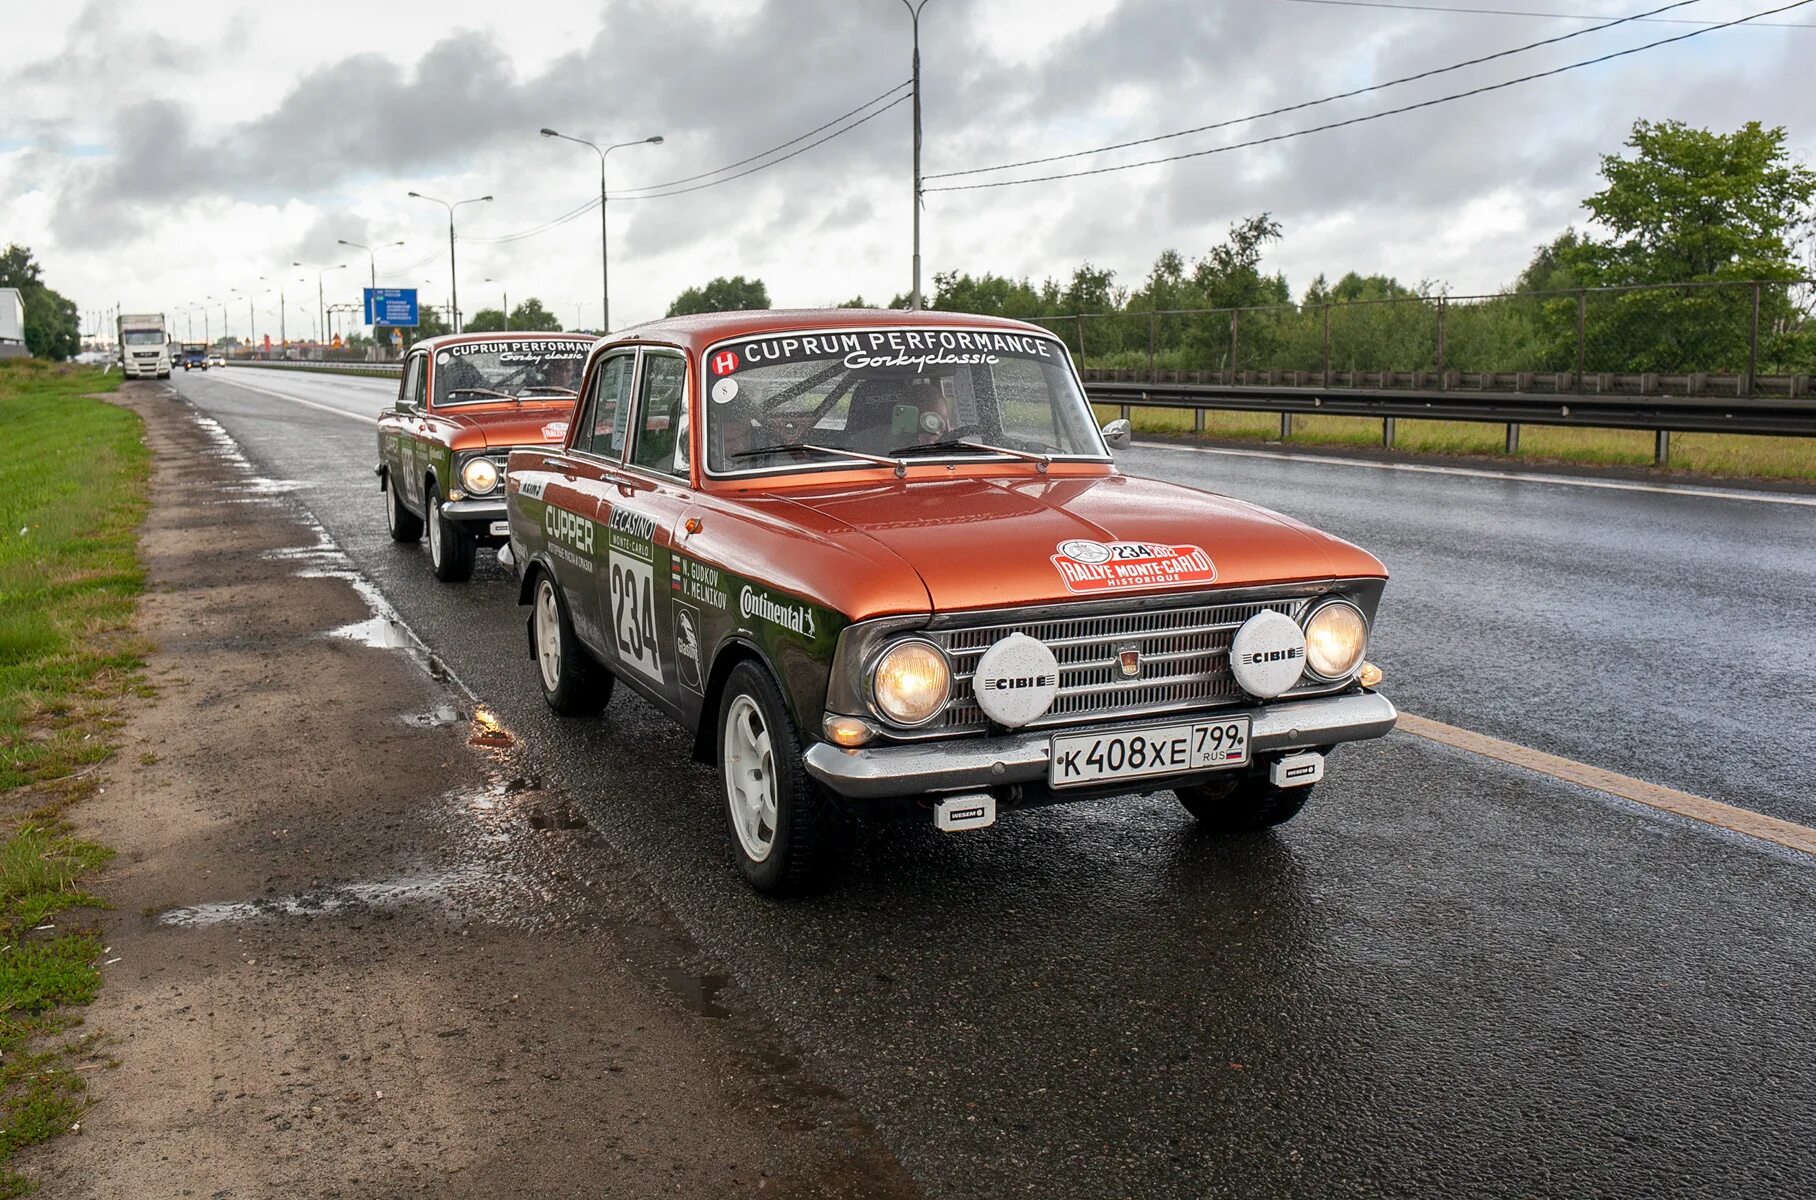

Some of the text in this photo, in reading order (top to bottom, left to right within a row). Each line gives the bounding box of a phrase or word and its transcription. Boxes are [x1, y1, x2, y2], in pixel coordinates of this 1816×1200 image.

[452, 342, 591, 356] CUPRUM PERFORMAN
[744, 332, 1051, 362] CUPRUM PERFORMANCE
[716, 353, 734, 374] H
[545, 505, 594, 555] CUPPER
[619, 511, 654, 541] CASINO
[1060, 561, 1116, 582] RALLYE
[1114, 551, 1210, 578] MONTE-CARLO
[1112, 545, 1151, 559] 234
[1150, 546, 1178, 558] 2022
[682, 559, 719, 588] N. GUDKOV
[1108, 574, 1180, 587] HISTORIQUE
[682, 579, 727, 611] V. MELNIKOV
[740, 585, 804, 634] Continental
[612, 563, 659, 671] 234
[1195, 724, 1239, 752] 799
[1203, 751, 1226, 762] RUS
[951, 810, 977, 820] WESEM
